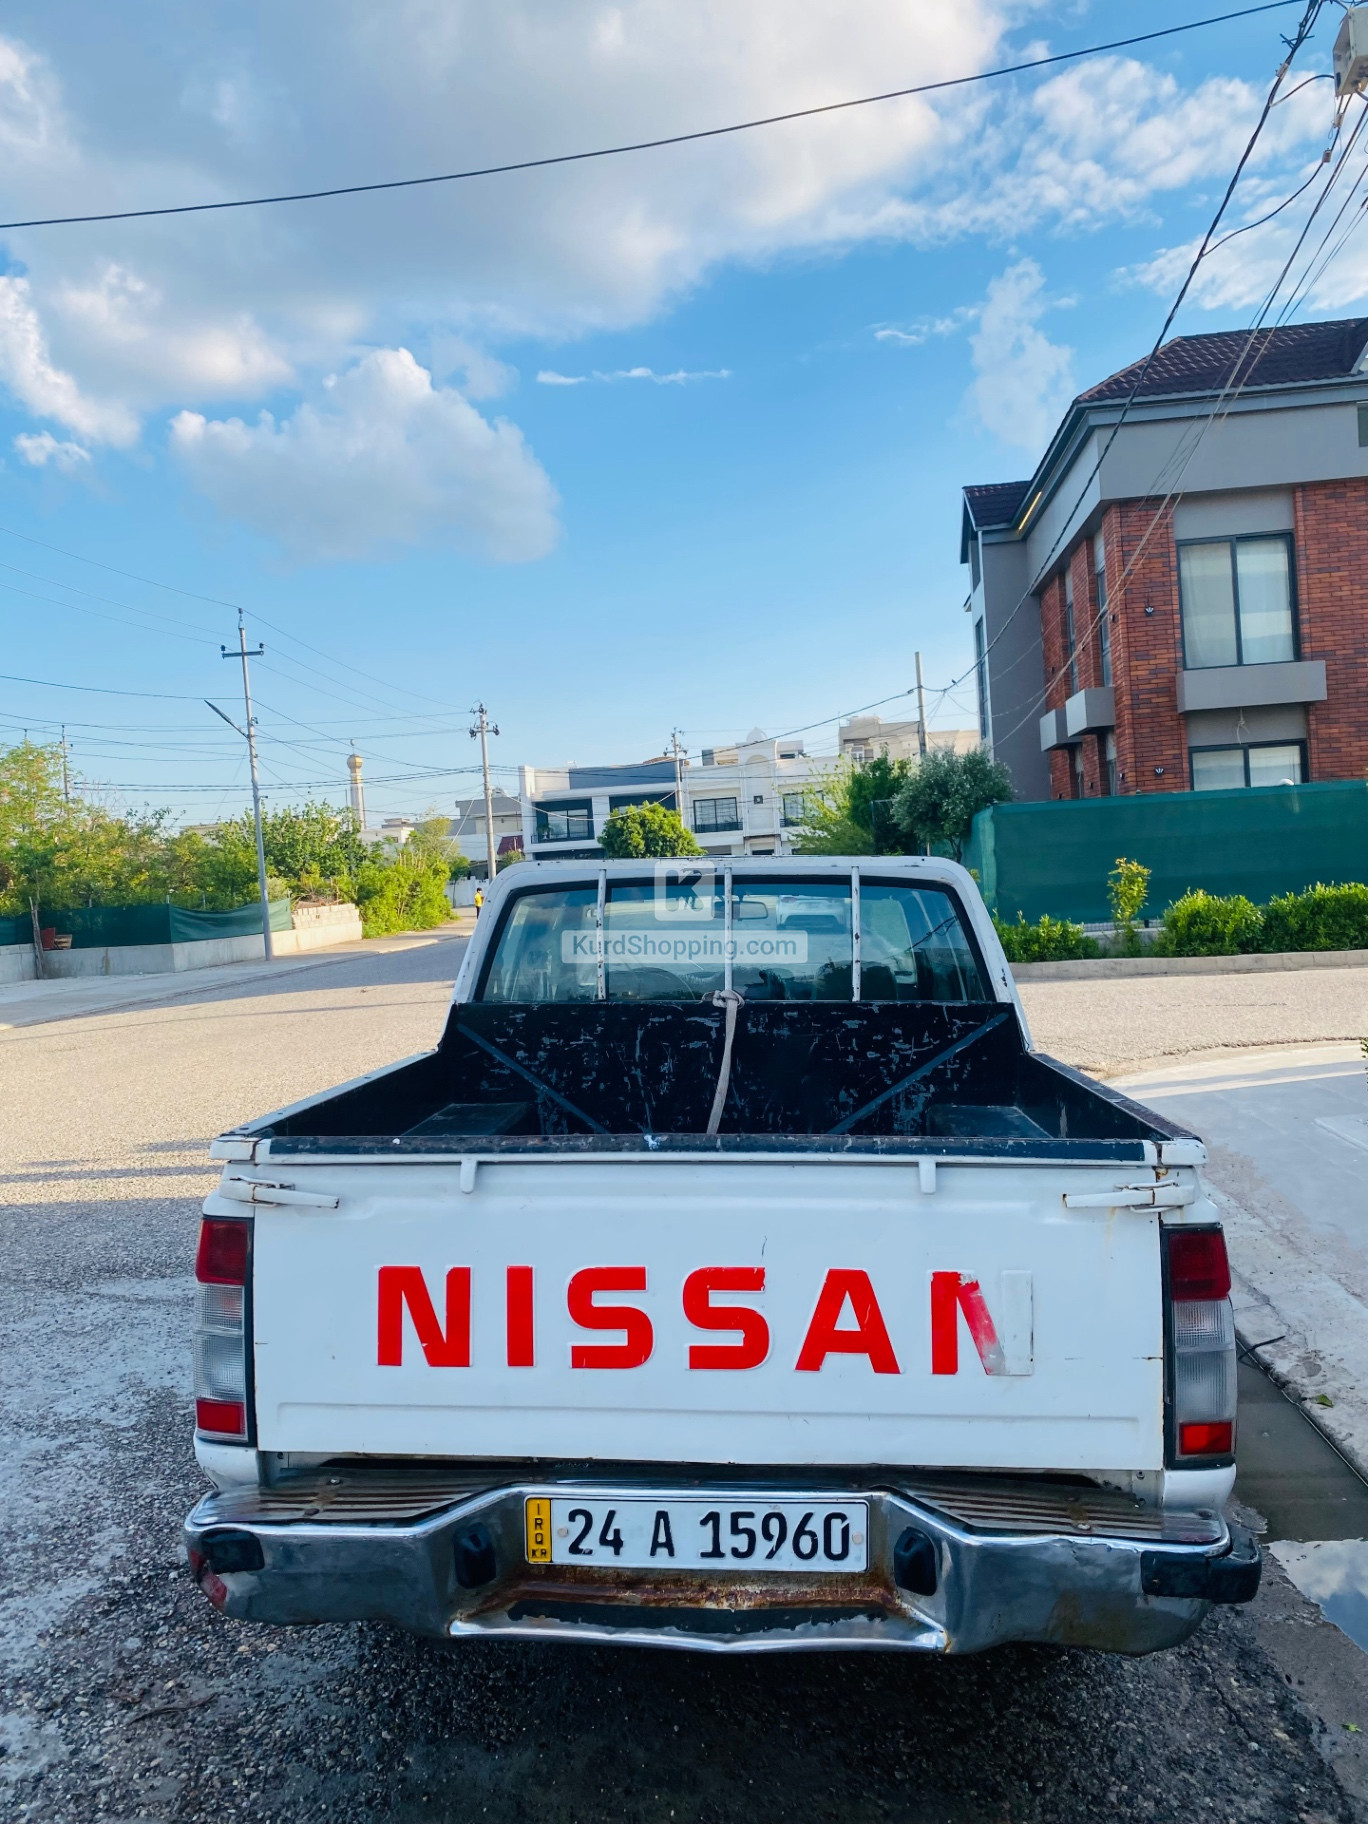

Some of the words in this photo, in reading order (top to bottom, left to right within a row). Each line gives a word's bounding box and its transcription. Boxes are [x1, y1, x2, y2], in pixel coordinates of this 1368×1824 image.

[377, 1265, 1032, 1376] NISSAN
[533, 1503, 545, 1546] IRQ
[567, 1508, 625, 1556] 24
[650, 1510, 675, 1557] A
[699, 1510, 850, 1561] 15960
